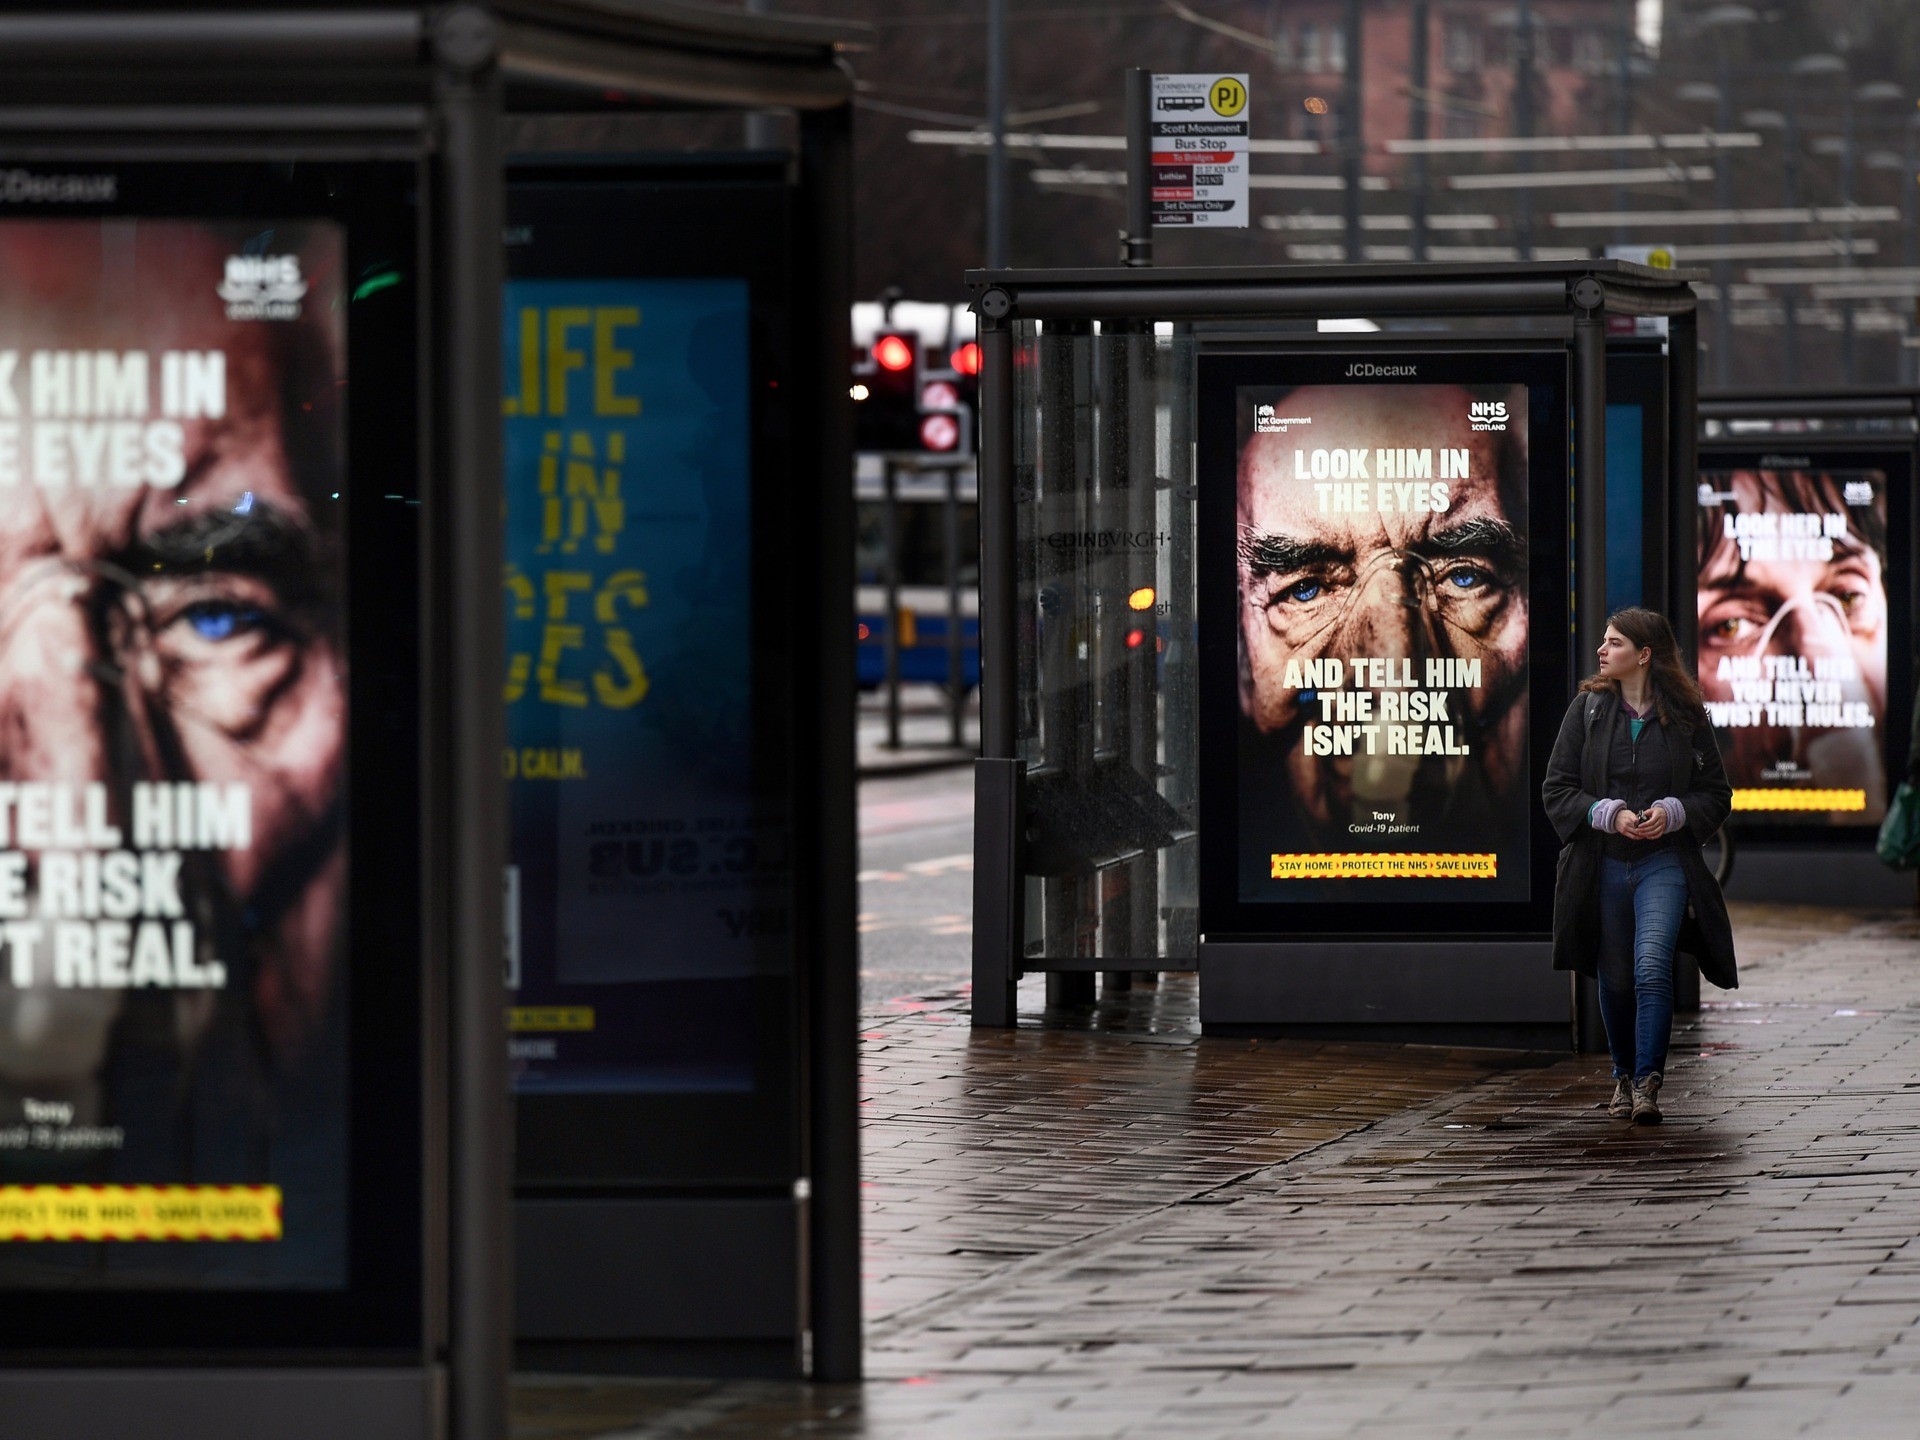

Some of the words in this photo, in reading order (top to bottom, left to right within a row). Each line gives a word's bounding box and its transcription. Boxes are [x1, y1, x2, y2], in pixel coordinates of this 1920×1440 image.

[1218, 87, 1238, 108] PJ
[1160, 123, 1186, 134] Scott
[1188, 123, 1241, 134] Monument
[1175, 138, 1197, 149] Bus
[1200, 138, 1227, 151] Stop
[1159, 172, 1187, 181] Lothian
[1164, 202, 1177, 210] Set
[1179, 202, 1204, 210] Down
[1205, 202, 1225, 212] Only
[1159, 214, 1187, 223] Lothian
[1345, 363, 1417, 377] JCDecaux
[30, 350, 149, 418] HIM
[161, 350, 227, 419] IN
[1471, 402, 1506, 416] NHS
[1258, 417, 1270, 425] UK
[1270, 416, 1312, 425] Government
[1471, 423, 1506, 431] SCOTLAND
[1258, 425, 1288, 433] Scotland
[34, 421, 187, 489] EYES
[1294, 449, 1369, 480] LOOK
[1376, 449, 1432, 479] HIM
[1440, 448, 1470, 479] IN
[1314, 483, 1369, 513] THE
[1377, 482, 1450, 513] EYES
[1283, 658, 1343, 689] AND
[1350, 658, 1418, 688] TELL
[1426, 658, 1481, 688] HIM
[1763, 656, 1812, 681] TELL
[1317, 691, 1373, 722] THE
[1380, 691, 1449, 722] RISK
[1304, 725, 1380, 756] ISN'T
[1387, 725, 1470, 756] REAL.
[133, 782, 251, 849] HIM
[1372, 811, 1396, 822] Tony
[1348, 823, 1386, 833] Covid-19
[1388, 824, 1420, 834] patient
[1279, 861, 1302, 871] STAY
[1305, 861, 1333, 870] HOME
[1342, 861, 1384, 870] PROTECT
[1387, 861, 1405, 869] THE
[1408, 861, 1428, 870] NHS
[1435, 861, 1460, 870] SAVE
[1462, 861, 1489, 870] LIVES
[40, 851, 184, 919] RISK
[55, 920, 227, 989] REAL.
